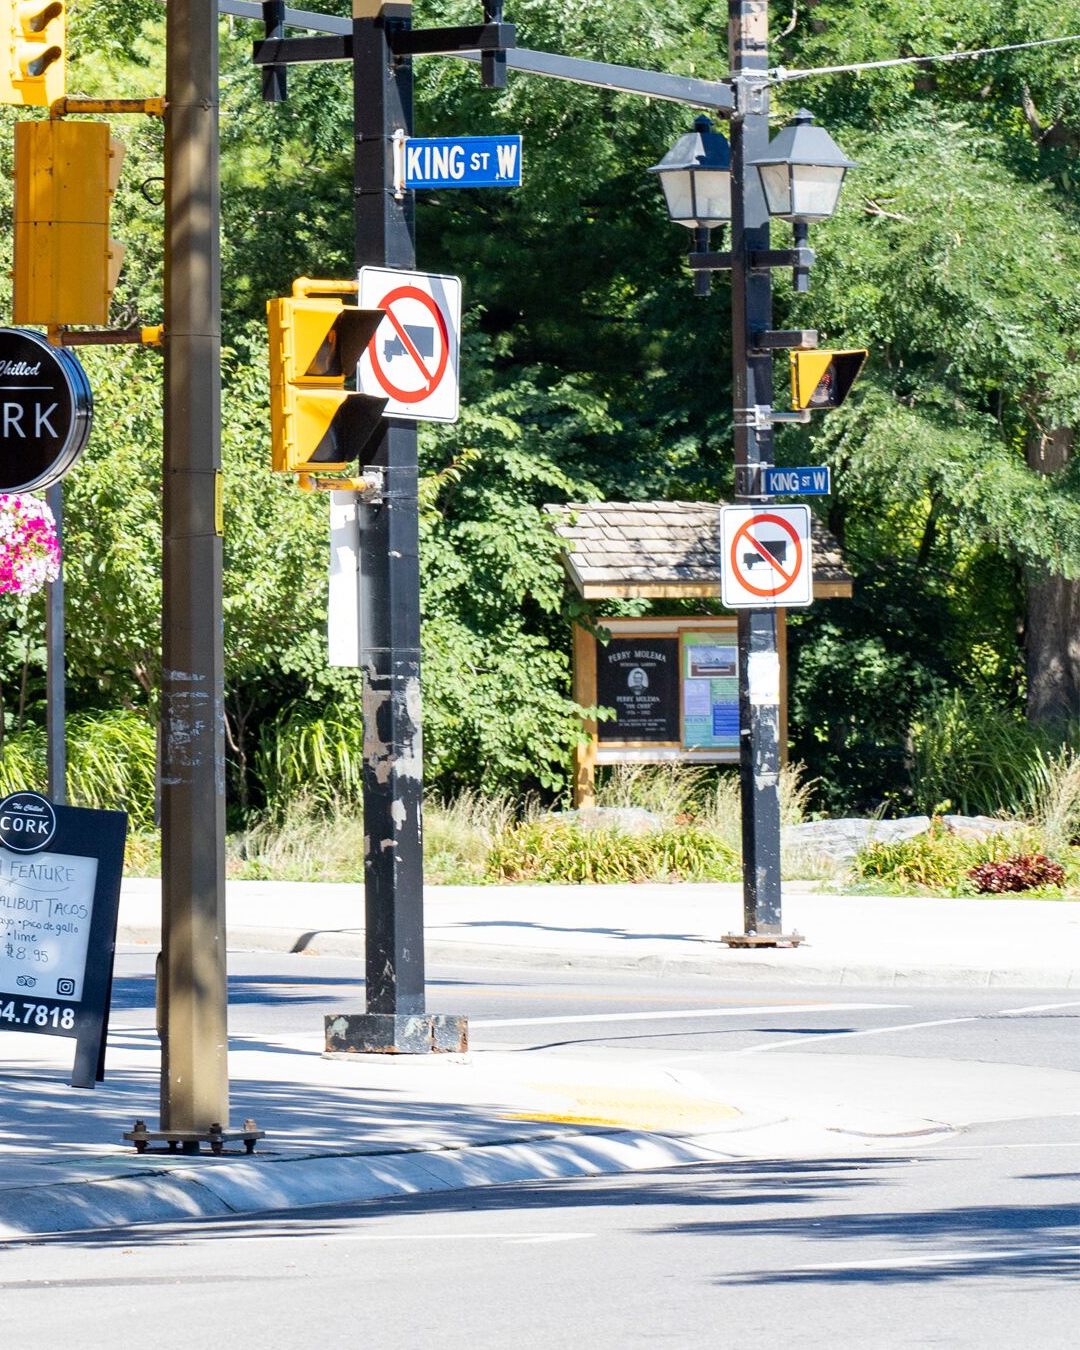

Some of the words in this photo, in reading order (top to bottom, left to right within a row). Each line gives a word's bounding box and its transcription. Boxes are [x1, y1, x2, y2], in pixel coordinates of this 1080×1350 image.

[407, 145, 465, 180] KING
[470, 152, 490, 170] ST
[496, 144, 517, 180] W
[770, 472, 799, 491] KING
[802, 476, 811, 487] ST
[813, 472, 826, 490] W
[608, 650, 631, 663] PERRY
[0, 816, 49, 835] CORK
[10, 860, 77, 882] FEATURE
[46, 898, 89, 919] TACOS
[13, 930, 38, 942] lime
[55, 922, 79, 936] gallo
